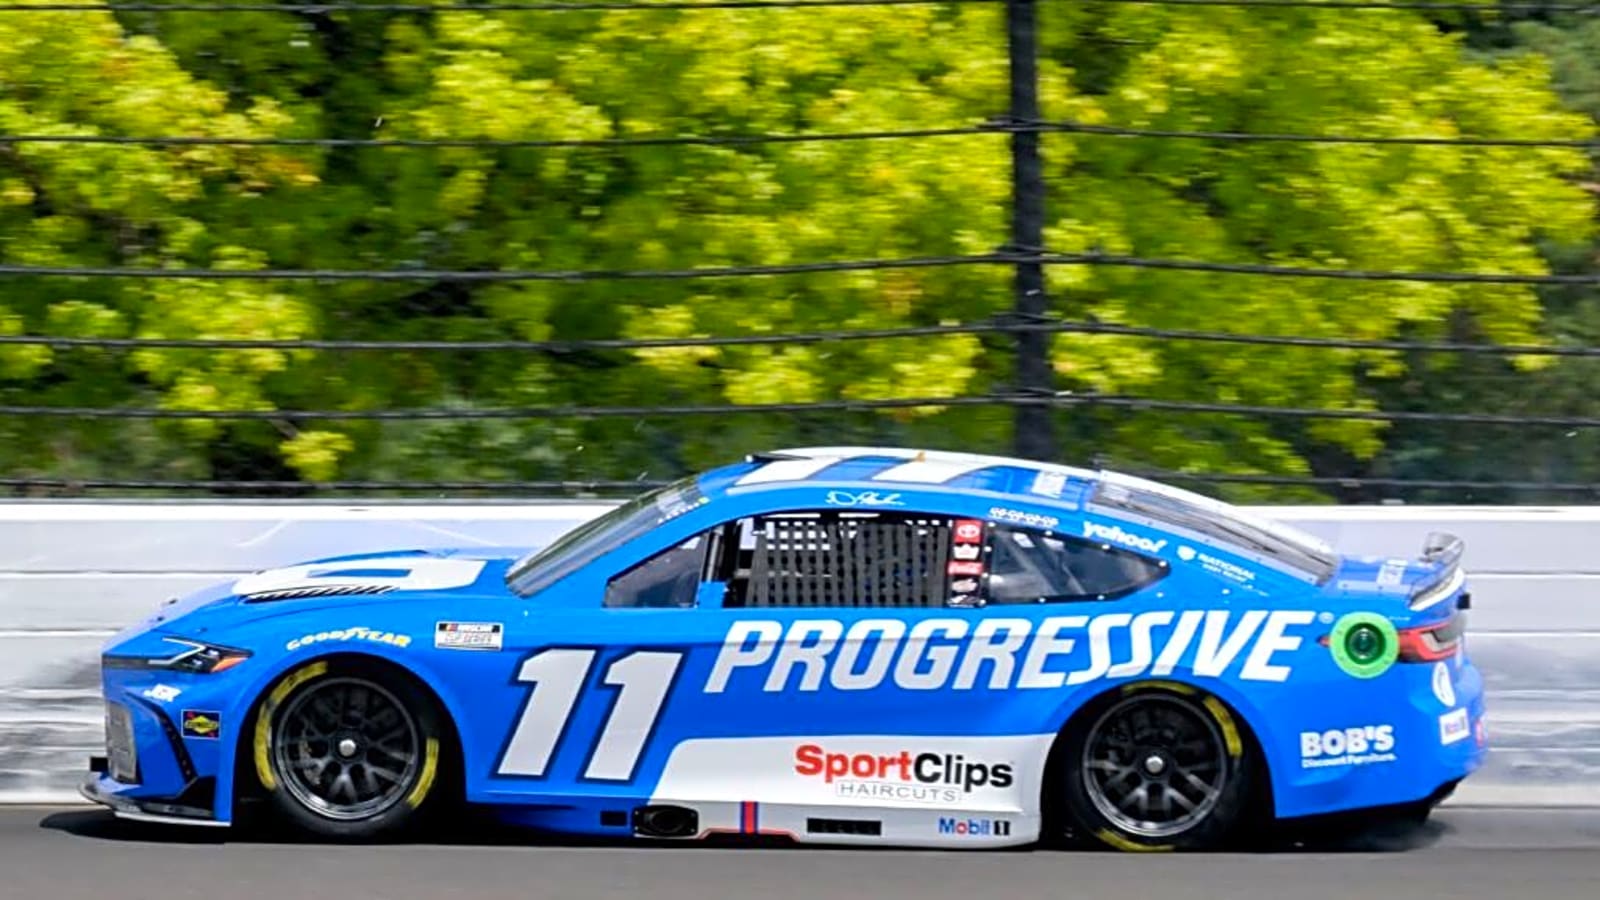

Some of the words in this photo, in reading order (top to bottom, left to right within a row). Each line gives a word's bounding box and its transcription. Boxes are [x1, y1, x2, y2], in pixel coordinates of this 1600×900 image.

[1083, 520, 1168, 553] yahoo!
[286, 627, 411, 650] GOODYEAR
[703, 609, 1317, 693] PROGRESSIVE
[497, 648, 683, 781] 11
[1301, 724, 1395, 757] BOB'S
[840, 783, 957, 801] HAIRCUTS
[939, 817, 990, 835] Mobil
